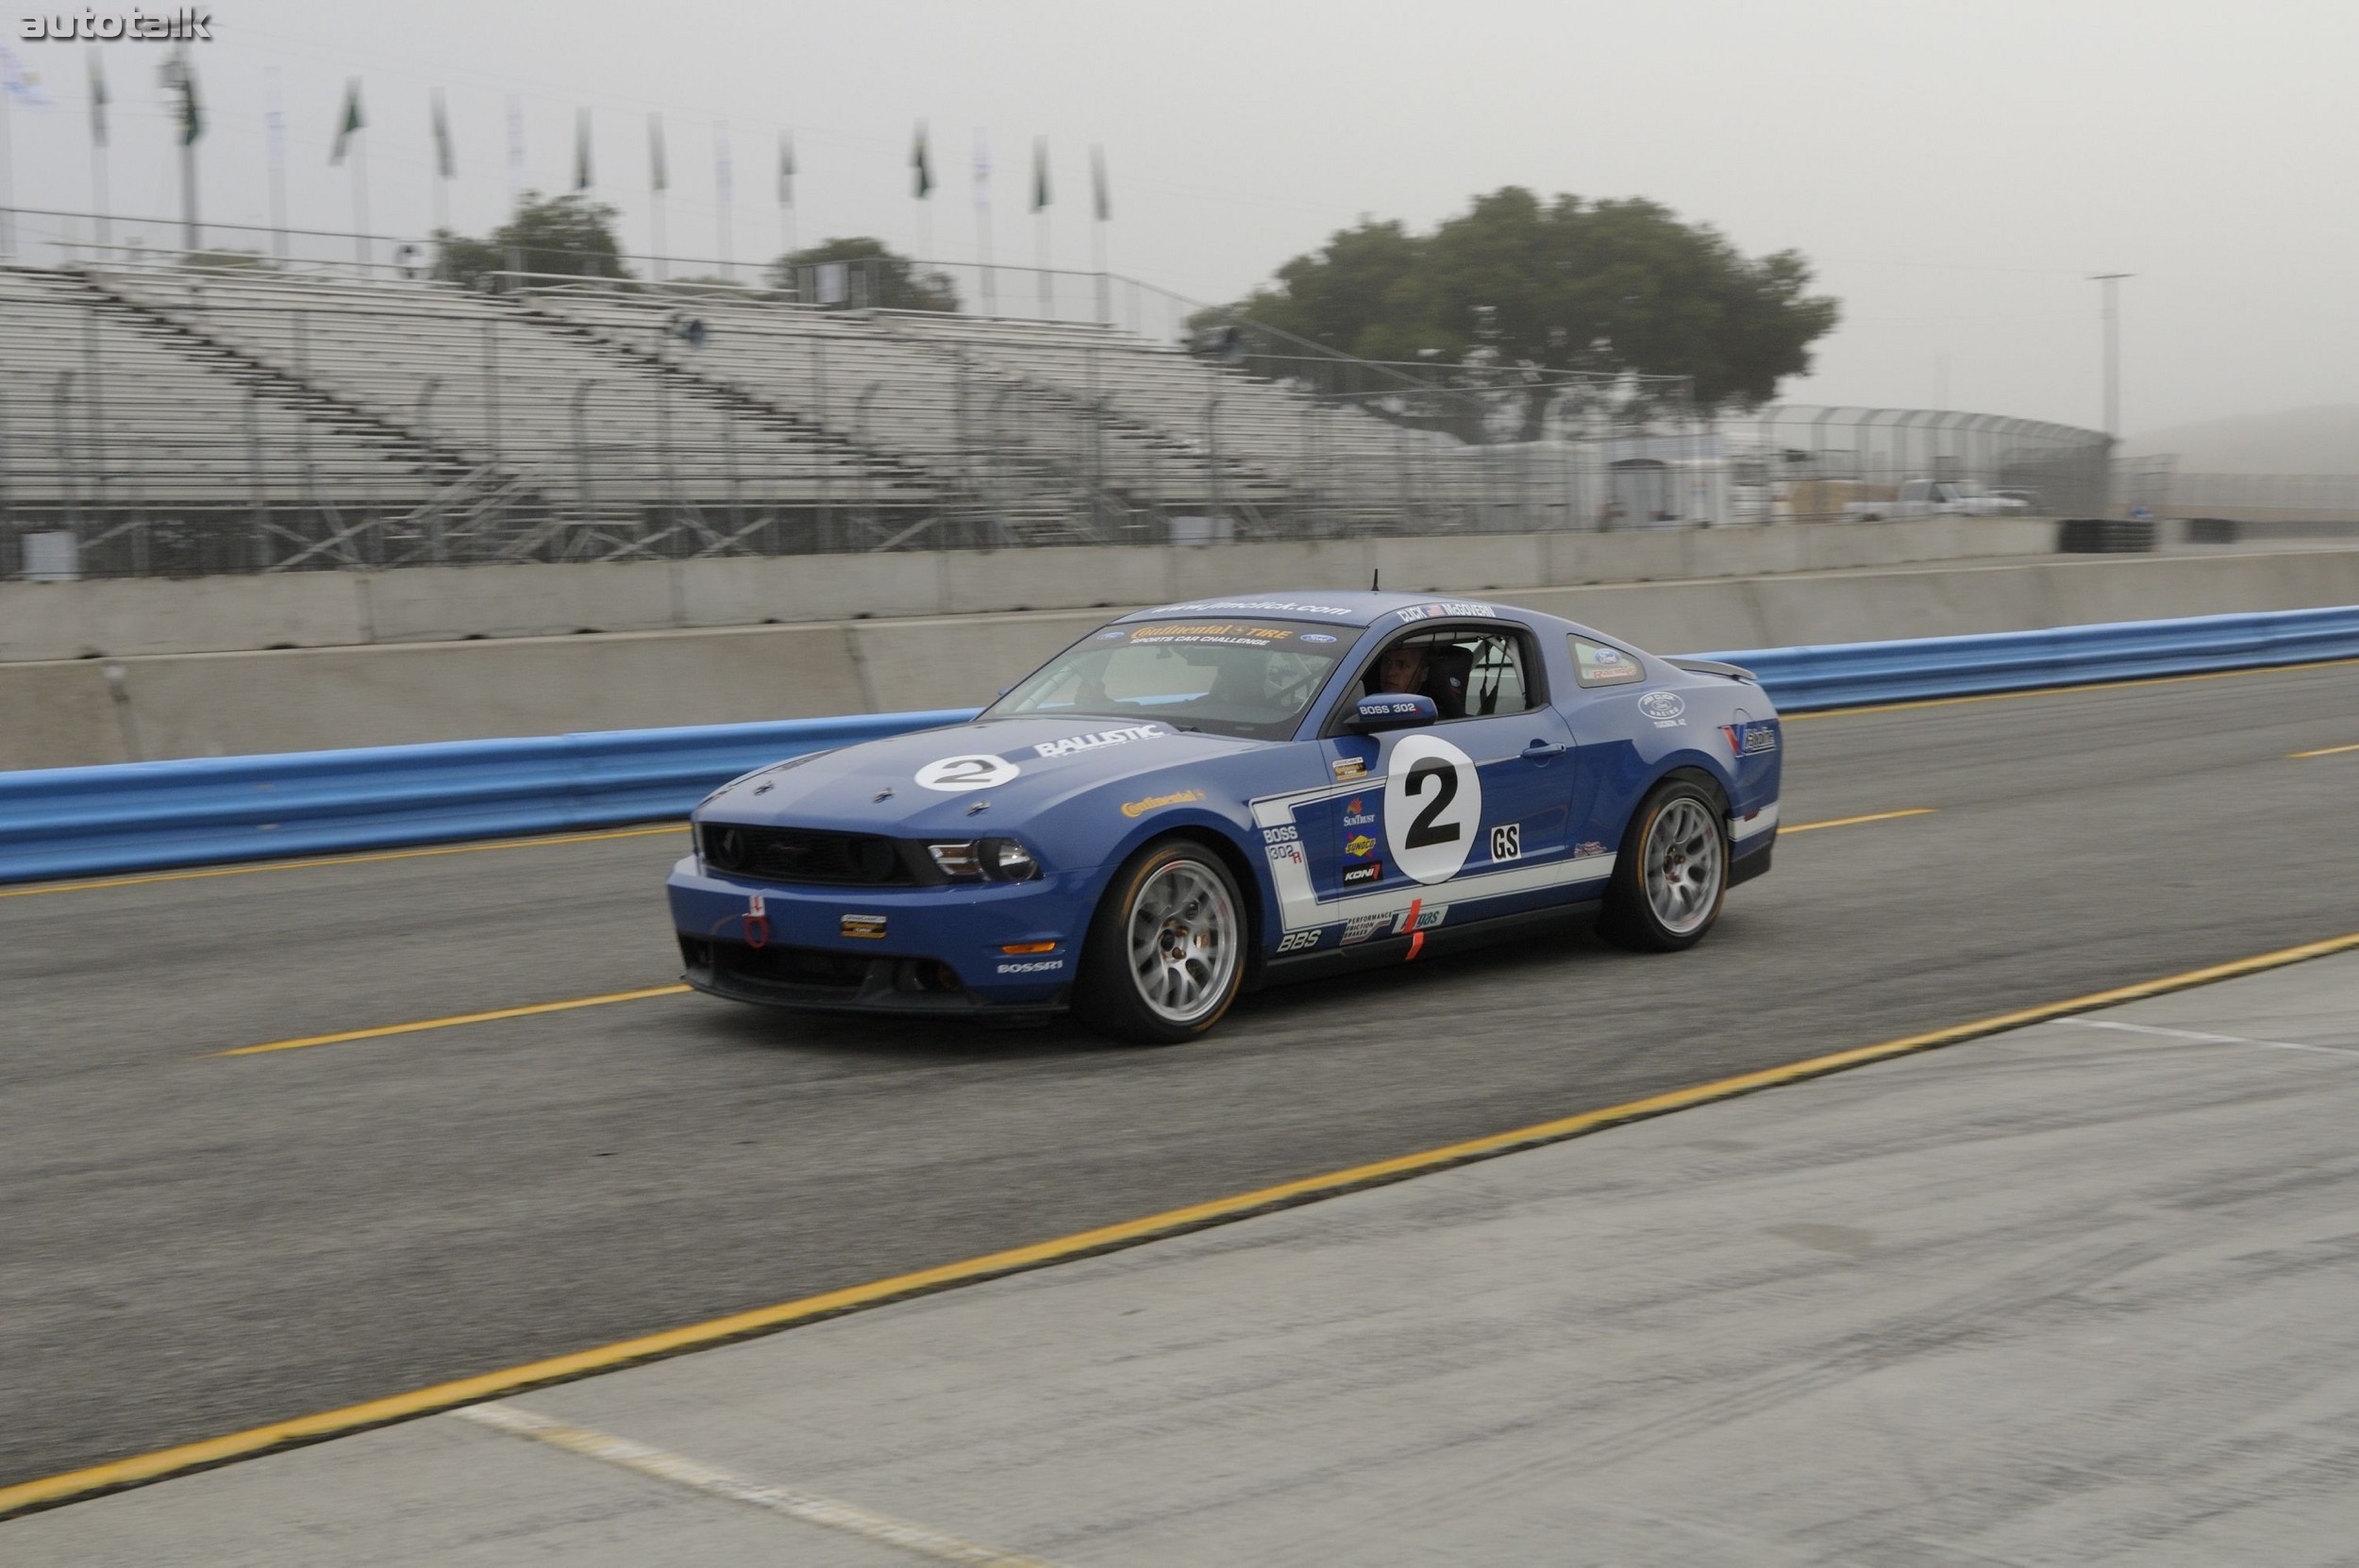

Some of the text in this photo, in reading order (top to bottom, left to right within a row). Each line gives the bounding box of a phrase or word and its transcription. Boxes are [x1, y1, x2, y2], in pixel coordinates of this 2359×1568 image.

[1397, 607, 1428, 623] CLICK
[1130, 625, 1294, 640] Continental TIRE
[1199, 636, 1271, 646] CHALLENGE
[1359, 705, 1390, 715] BOSS
[1033, 725, 1164, 759] BALLISTIC
[932, 759, 997, 783] 2
[1405, 757, 1461, 850] 2
[1263, 826, 1298, 844] BOSS
[1492, 826, 1519, 860] GS
[1346, 837, 1377, 853] SUNOCO
[1345, 867, 1375, 881] KONI
[1347, 910, 1393, 925] PERFORMANCE
[1346, 922, 1375, 932] FRICTION
[1277, 928, 1321, 953] BBS
